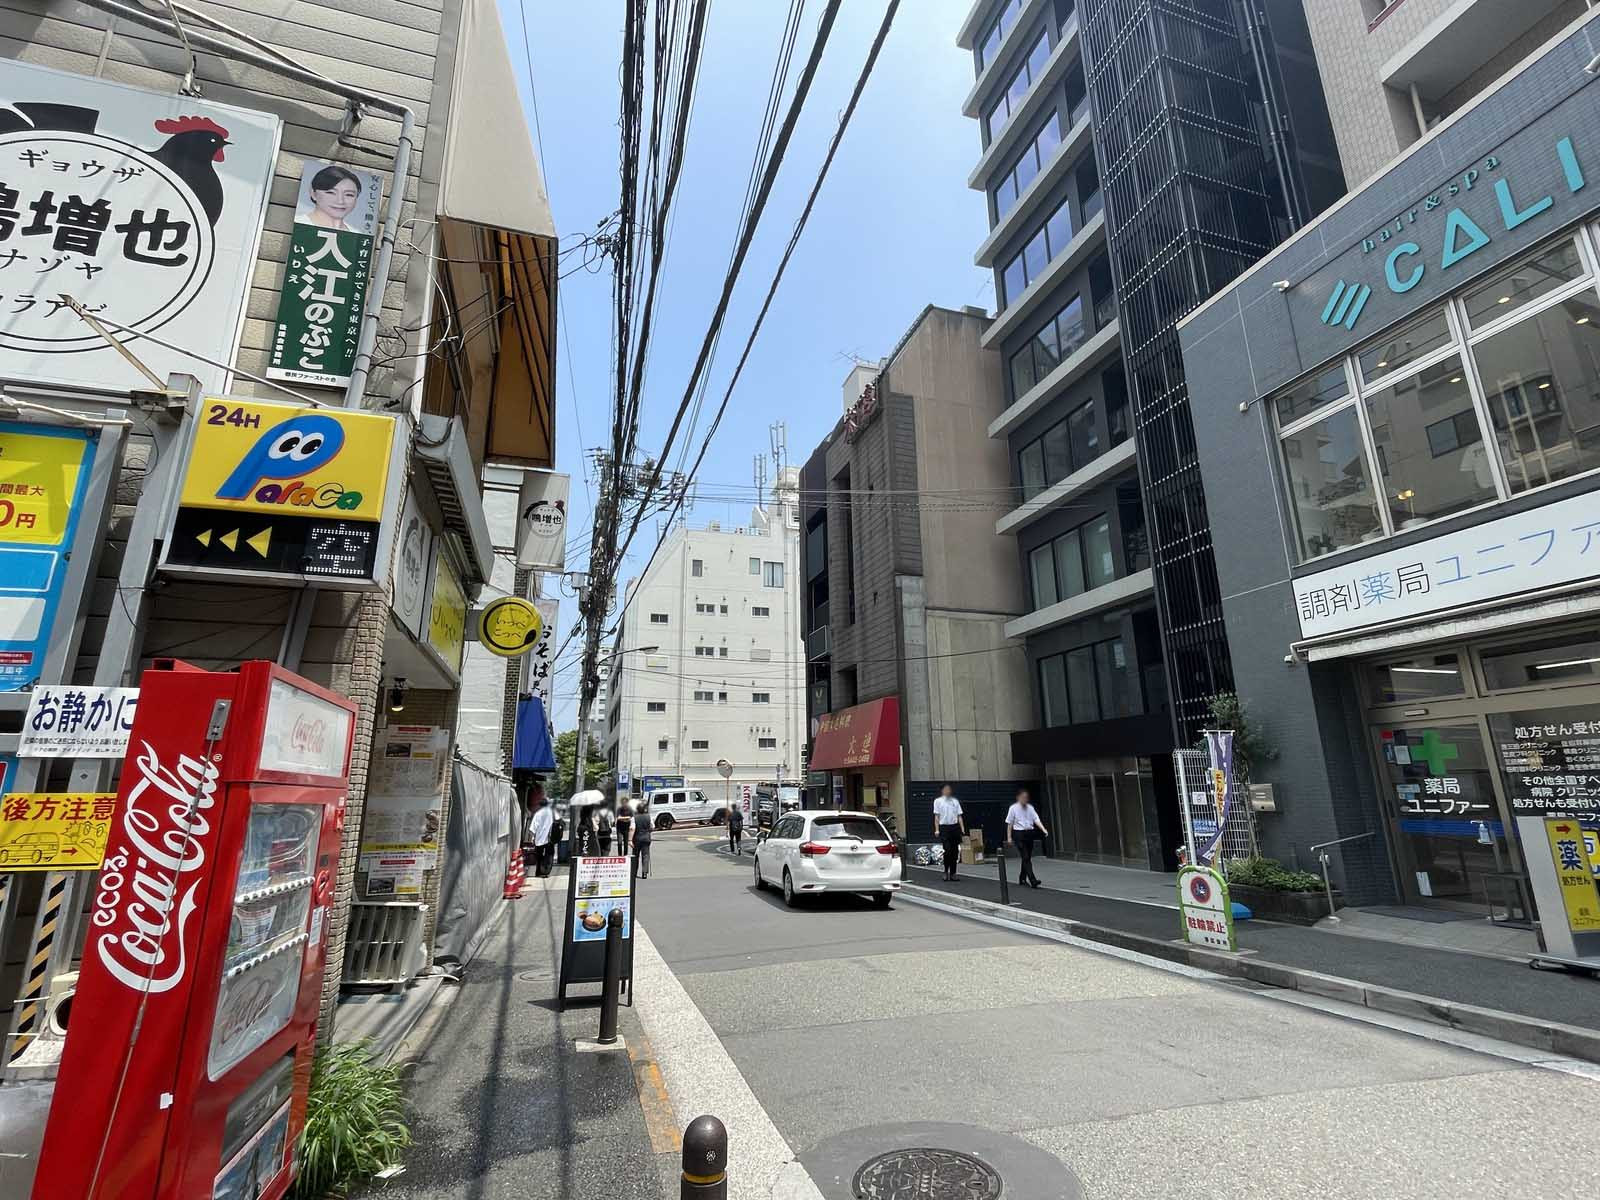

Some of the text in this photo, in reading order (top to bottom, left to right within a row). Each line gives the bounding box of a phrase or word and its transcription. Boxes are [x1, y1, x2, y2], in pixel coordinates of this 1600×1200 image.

[18, 149, 145, 183] ギョウザ
[0, 181, 191, 267] 増也
[288, 244, 305, 285] いりえ
[298, 230, 352, 370] 入江のぶこ
[207, 404, 261, 429] 24H
[306, 523, 371, 575] 空
[32, 691, 139, 733] お静かに
[1514, 721, 1600, 739] 処方せん受付
[1424, 778, 1460, 794] 薬局
[1531, 787, 1554, 797] 病院
[2, 797, 117, 821] 後方注意
[1408, 799, 1490, 814] ユニファー
[98, 739, 221, 993] Coca-Cola
[1557, 840, 1583, 870] 薬
[1187, 917, 1226, 934] 駐輪禁止
